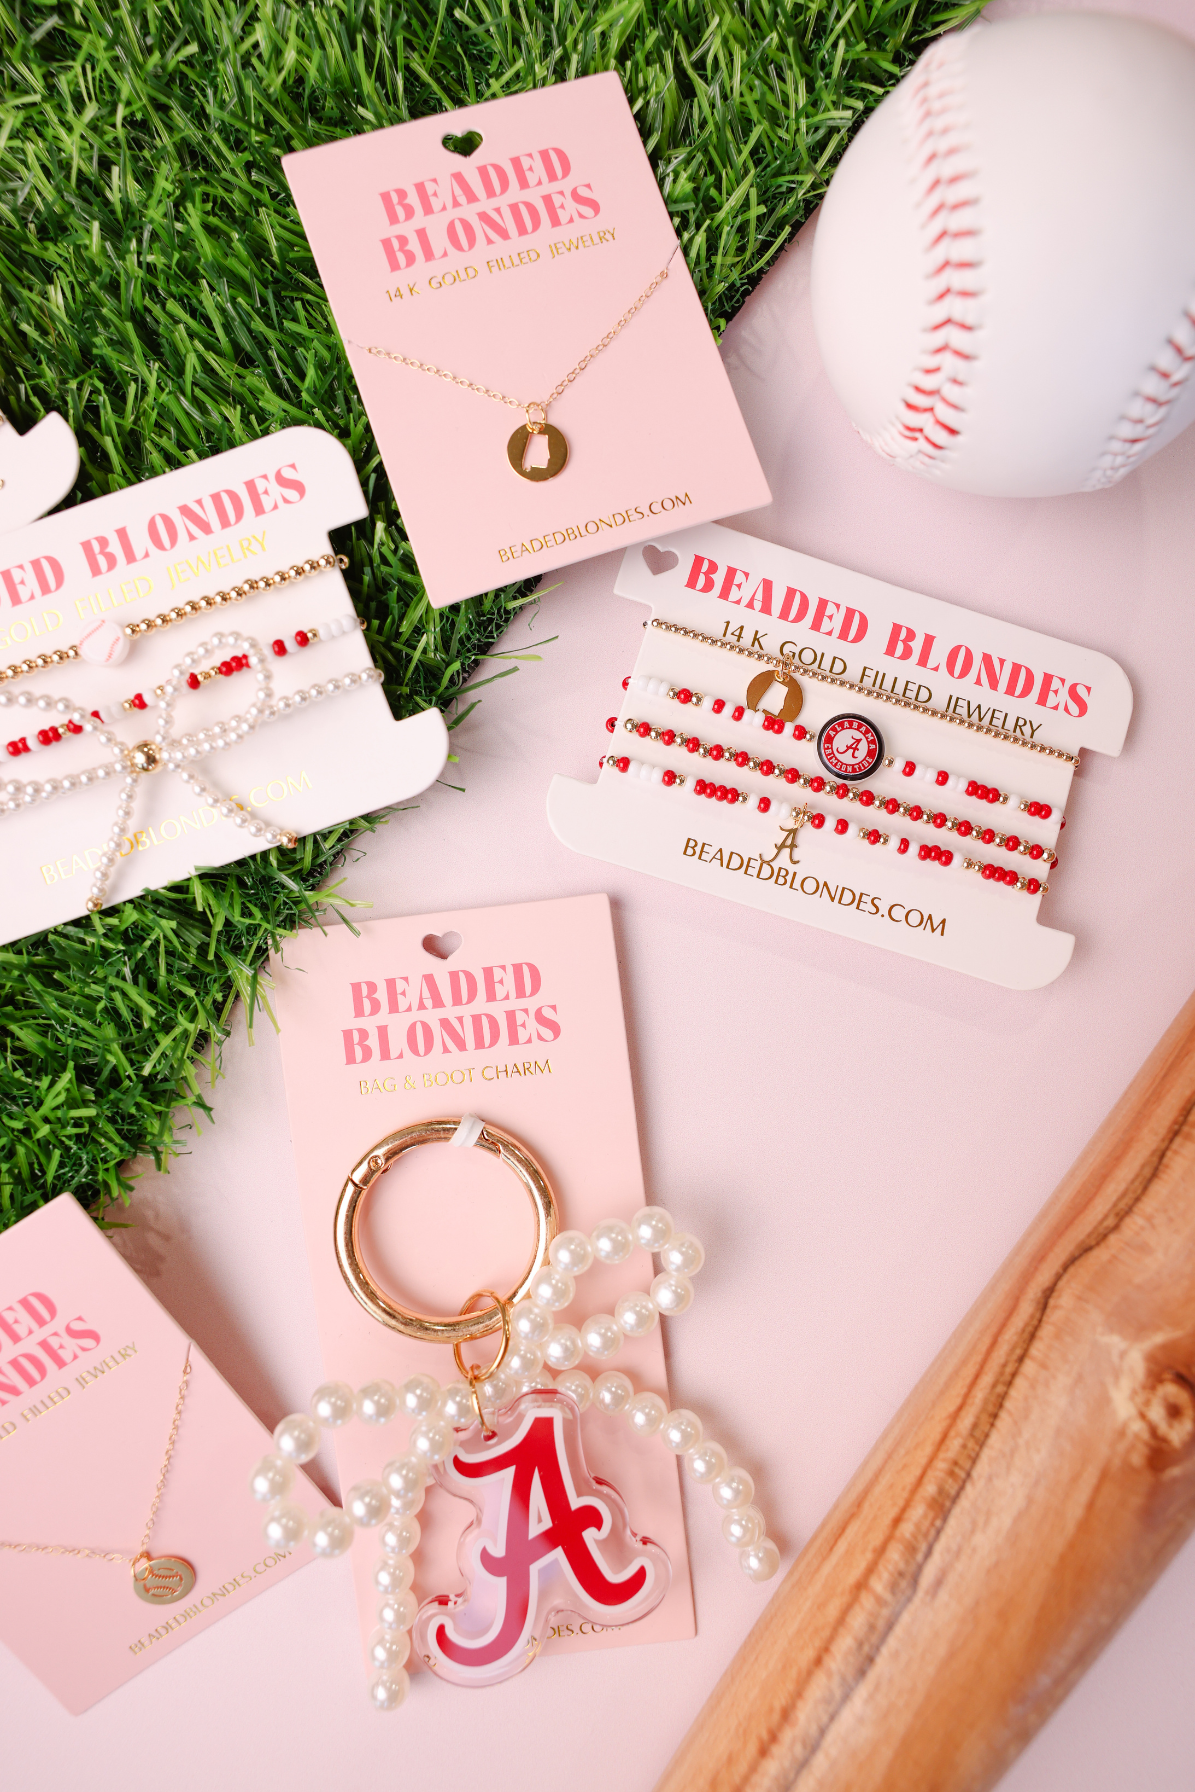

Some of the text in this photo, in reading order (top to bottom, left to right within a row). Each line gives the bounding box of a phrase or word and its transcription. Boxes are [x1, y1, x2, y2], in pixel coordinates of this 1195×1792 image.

[378, 147, 572, 227] BEADED
[379, 183, 601, 273] BLONDES
[428, 265, 479, 290] GOLD
[486, 248, 541, 274] FILLED
[549, 227, 616, 259] JEWELRY
[0, 462, 306, 608] ED BLONDES
[498, 492, 693, 563] BEADEDBLONDES.COM
[74, 576, 154, 620] FILLED
[166, 530, 268, 590] JEWELRY
[684, 554, 1092, 718] BEADED BLONDES
[779, 641, 847, 676] GOLD
[859, 666, 933, 704] FILLED
[945, 694, 1042, 739] JEWELRY
[824, 743, 873, 773] CRIMSON TIDE
[828, 721, 876, 750] ALABAMA
[682, 837, 947, 936] BEADEDBLONDES.COM
[349, 962, 542, 1019] BEADED
[341, 1004, 562, 1065] BLONDES
[359, 1059, 553, 1095] BAG & BOOT CHARM
[0, 1291, 57, 1346] ED
[21, 1386, 71, 1424] FILLED
[75, 1341, 138, 1391] JEWELRY
[429, 1409, 654, 1672] A
